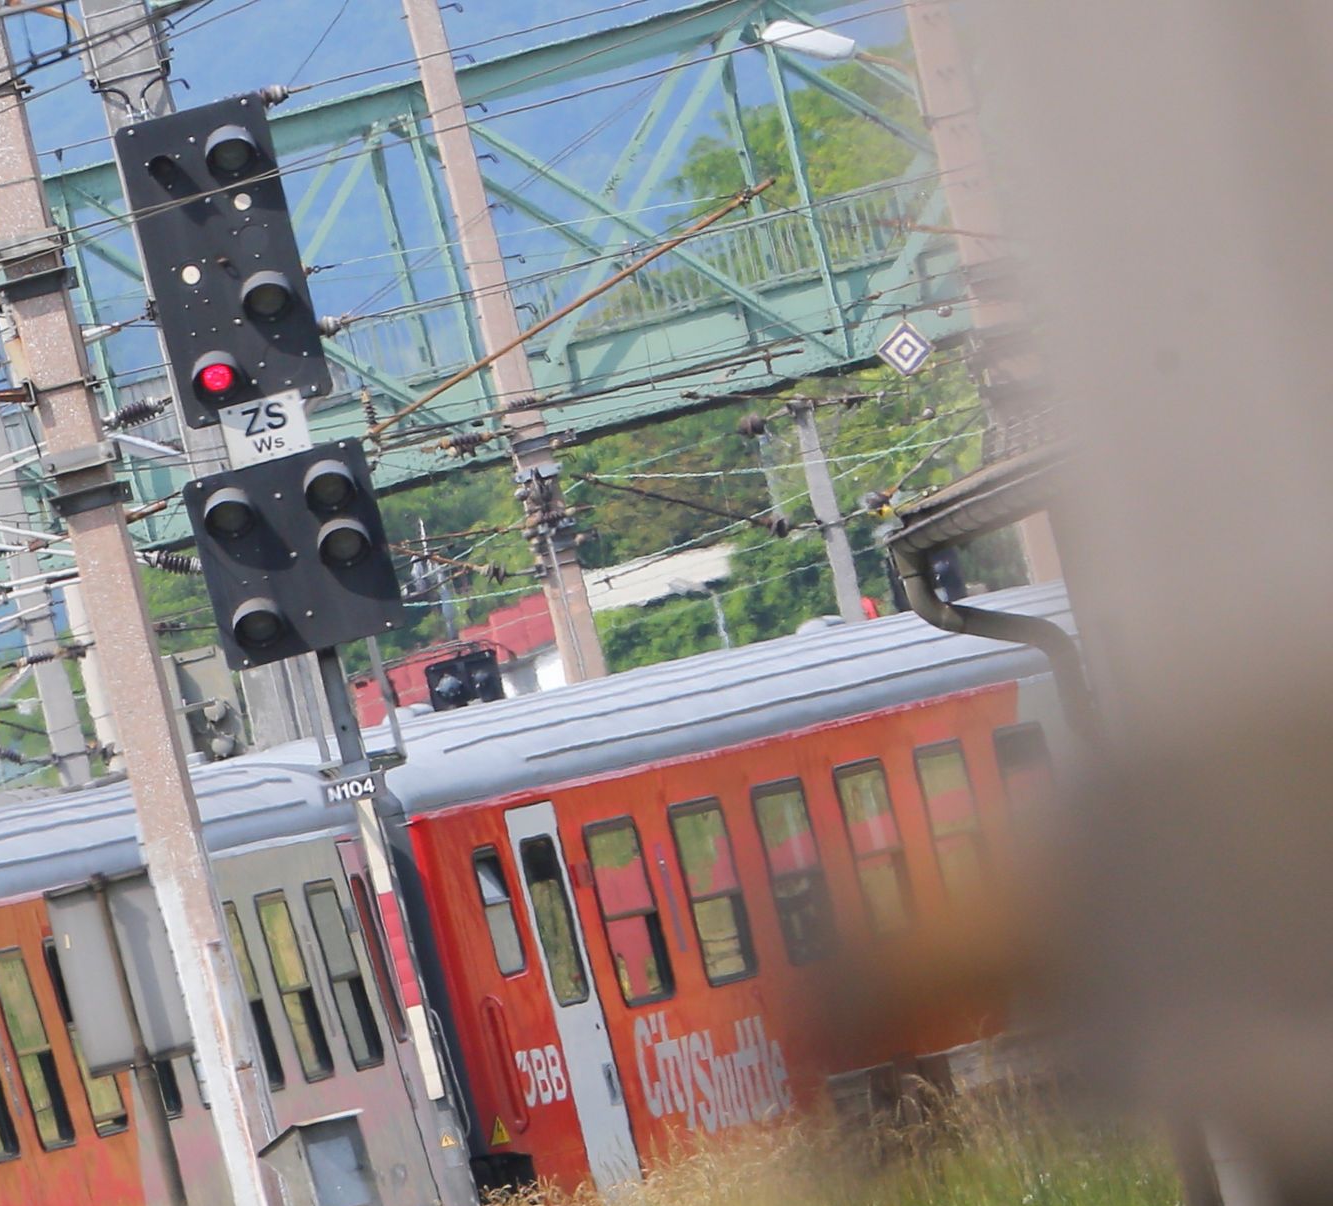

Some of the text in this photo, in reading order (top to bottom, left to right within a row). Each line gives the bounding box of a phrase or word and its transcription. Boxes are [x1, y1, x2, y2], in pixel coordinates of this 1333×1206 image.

[241, 402, 287, 437] ZS
[253, 435, 285, 453] Ws
[327, 777, 375, 802] N104
